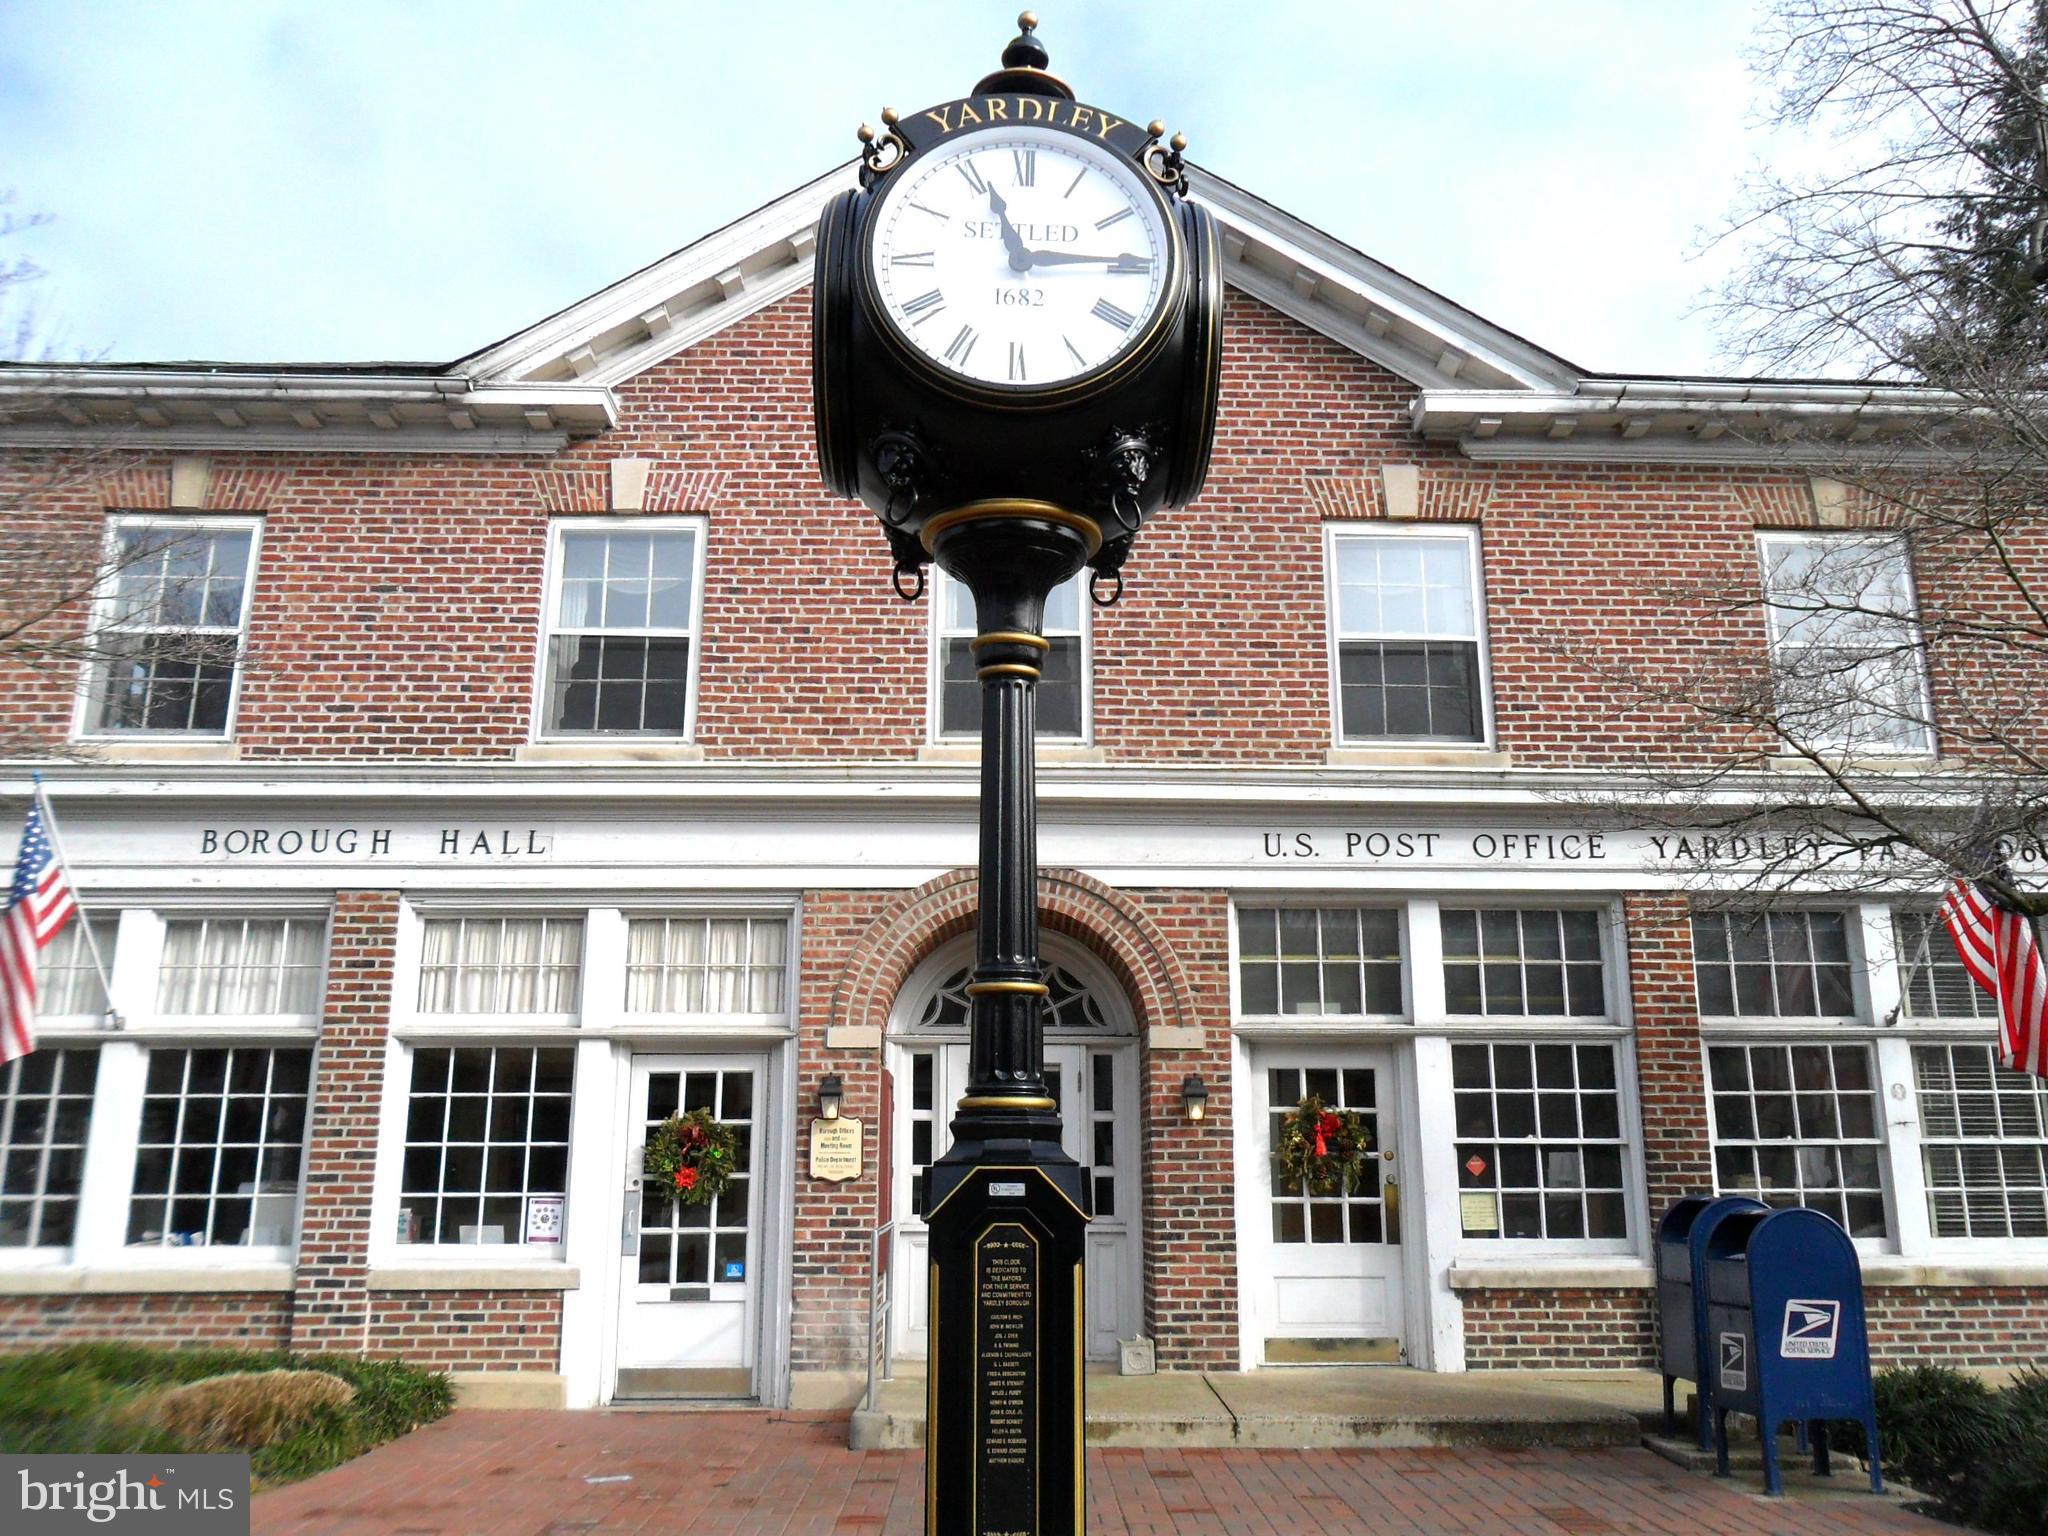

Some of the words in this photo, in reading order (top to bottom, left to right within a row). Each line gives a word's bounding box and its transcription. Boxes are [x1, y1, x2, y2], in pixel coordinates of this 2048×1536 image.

[925, 97, 1123, 140] YARDLEY
[995, 288, 1044, 307] 1682
[200, 829, 392, 855] BOROUGH
[439, 829, 547, 855] HALL
[1263, 832, 1319, 858] U.S.
[1345, 832, 1440, 858] POST
[1472, 833, 1606, 860] OFFICE
[820, 1142, 838, 1150] Meeting
